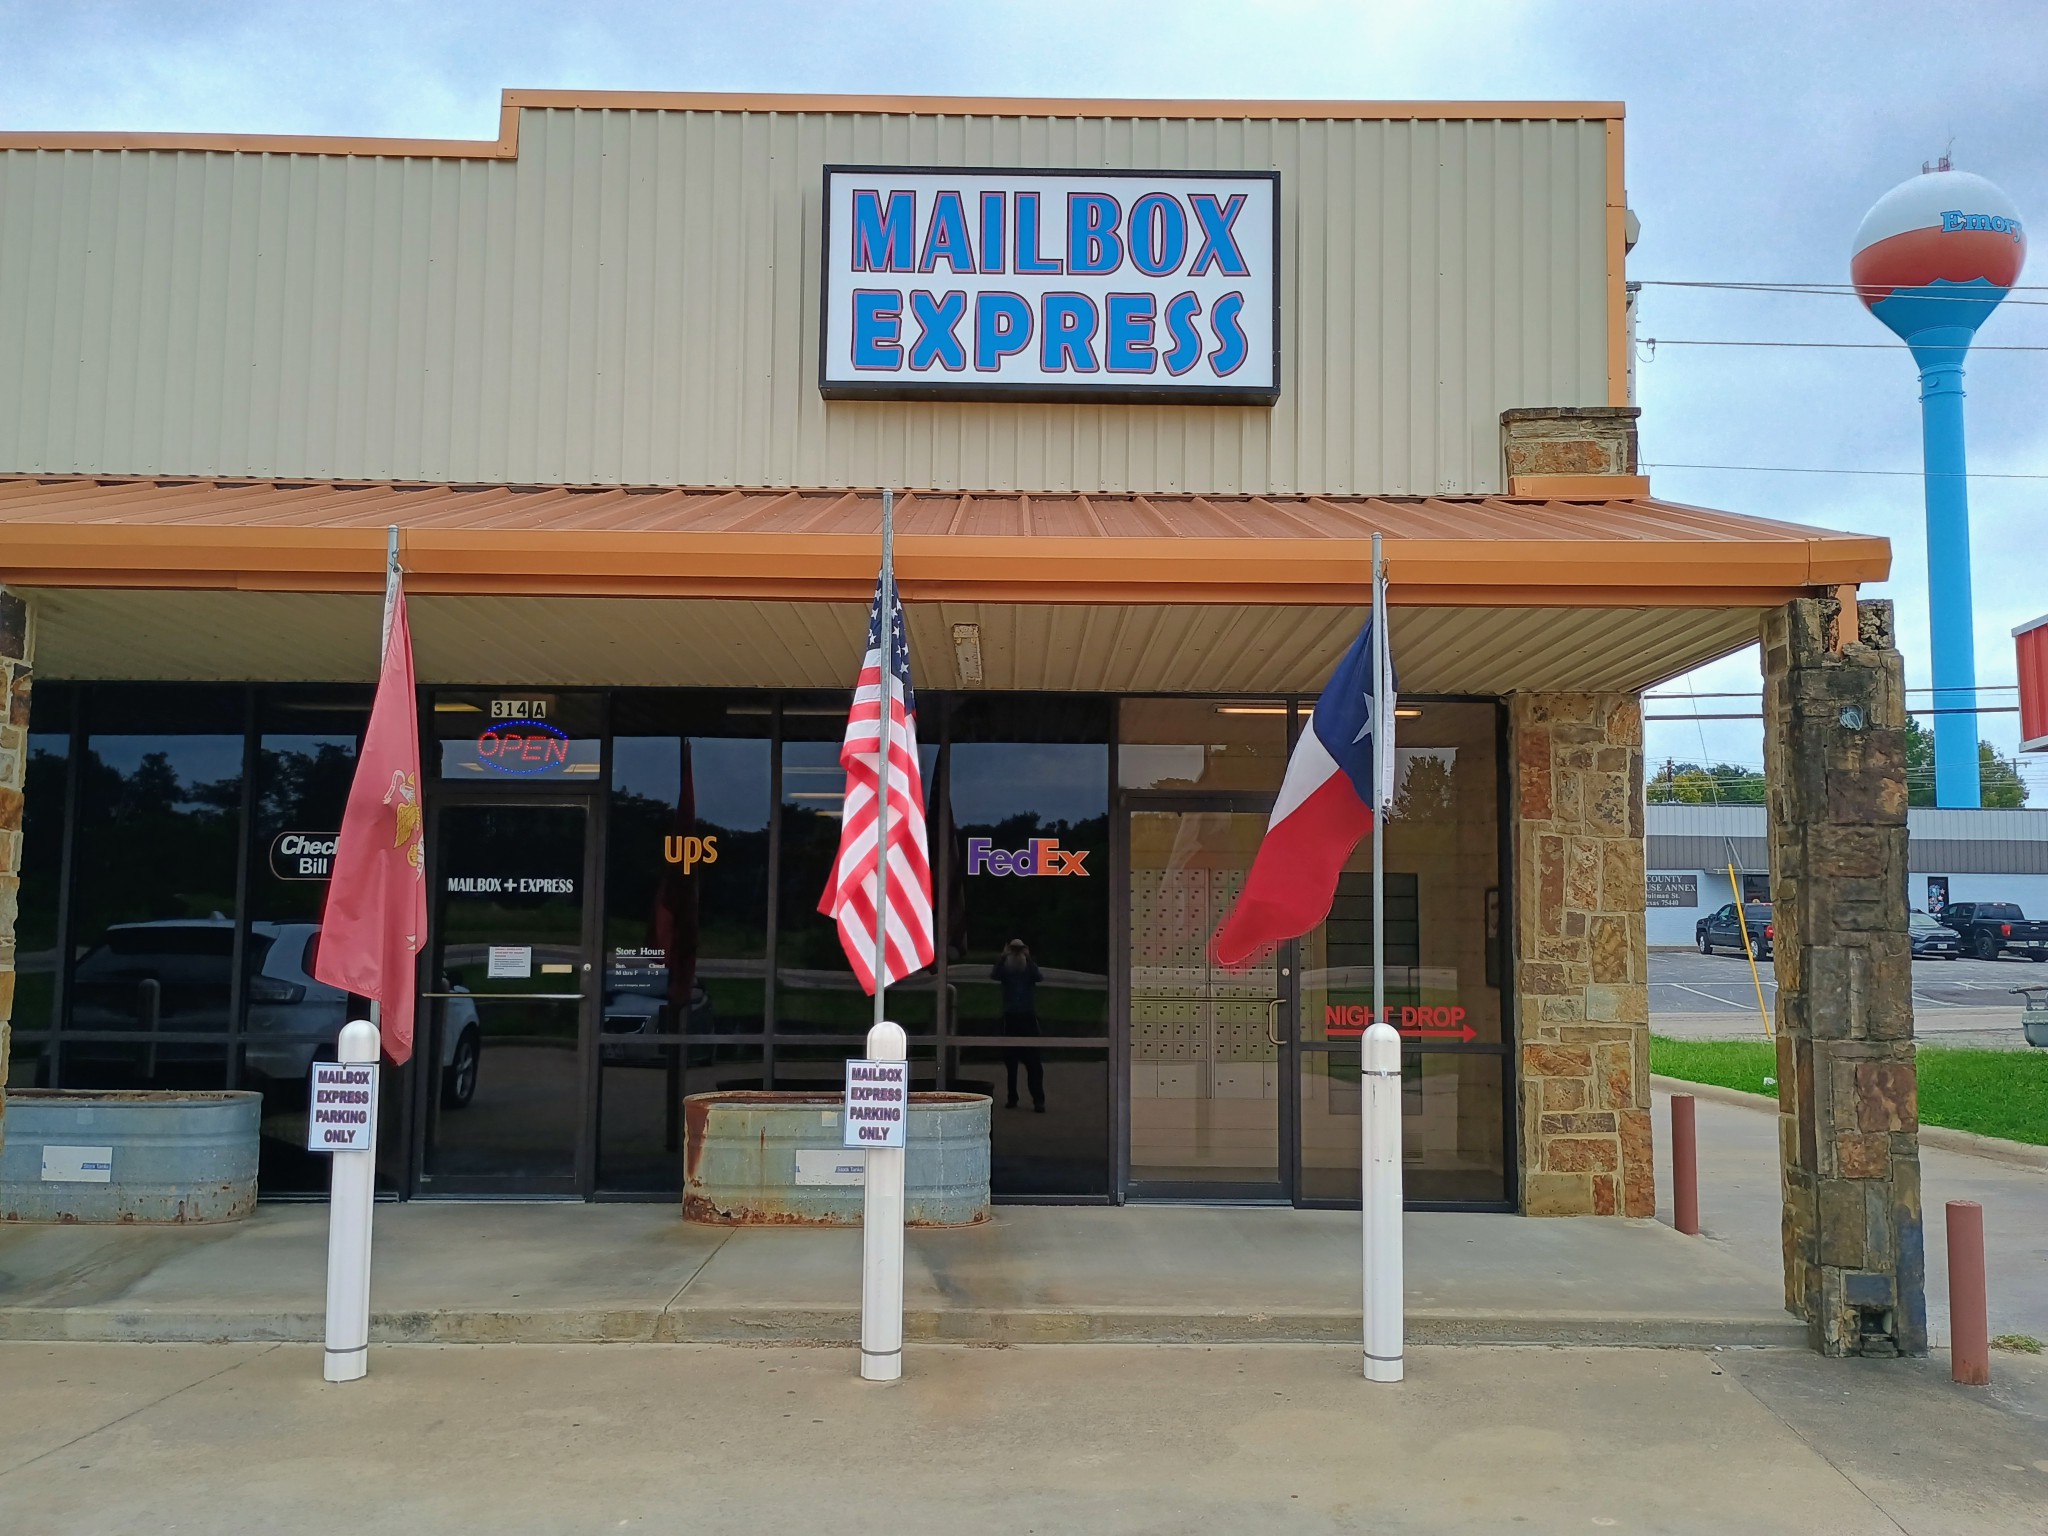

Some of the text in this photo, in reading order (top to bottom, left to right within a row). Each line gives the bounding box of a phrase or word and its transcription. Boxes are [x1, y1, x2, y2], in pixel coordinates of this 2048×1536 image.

[851, 189, 1251, 277] MAILBOX
[1940, 210, 2023, 243] Emory
[851, 288, 1248, 377] EXPRESS
[493, 702, 545, 717] 314 A
[478, 732, 569, 762] OPEN
[664, 835, 718, 875] ups
[968, 837, 1090, 877] FedEx
[299, 857, 328, 875] Bill
[447, 877, 502, 892] MAILBOX
[519, 878, 574, 893] EXPRESS
[1646, 875, 1682, 883] COUNTY
[1646, 883, 1696, 892] USE ANNEX
[615, 947, 665, 955] Store Hours
[1401, 1006, 1466, 1028] DROP
[317, 1070, 371, 1085] MAILBOX
[851, 1067, 903, 1082] MAILBOX
[316, 1089, 370, 1105] EXPRESS
[850, 1086, 902, 1102] EXPRESS
[315, 1109, 368, 1125] PARKING
[849, 1106, 901, 1122] PARKING
[323, 1128, 357, 1144] ONLY
[858, 1126, 891, 1141] ONLY
